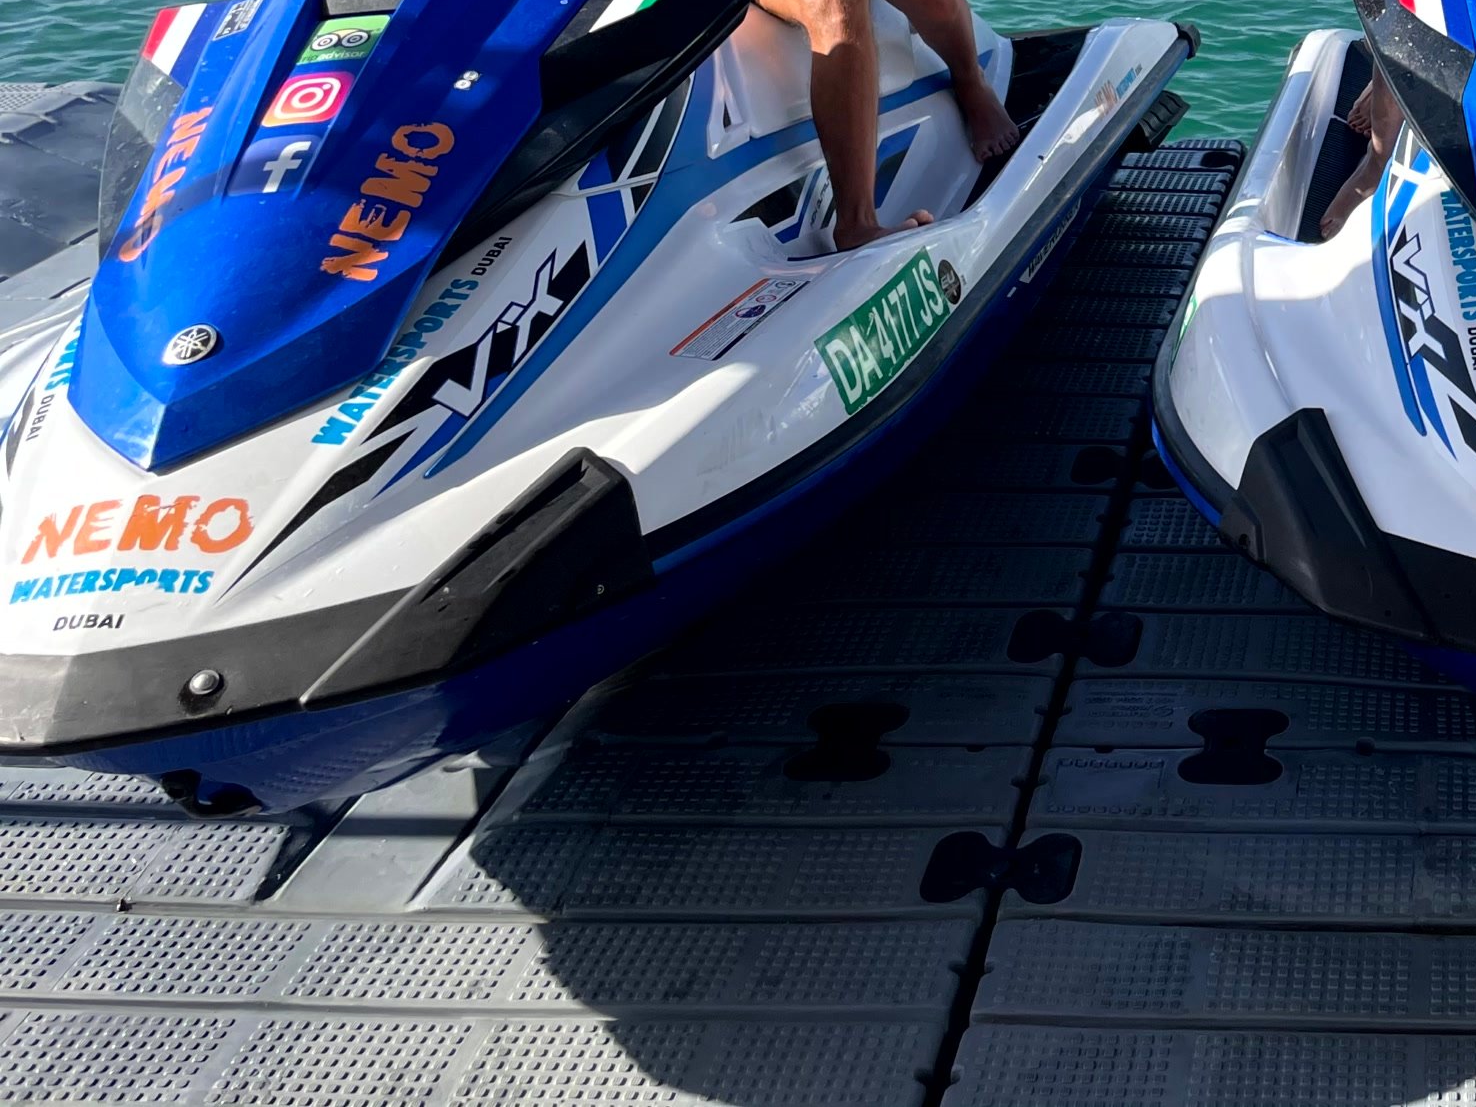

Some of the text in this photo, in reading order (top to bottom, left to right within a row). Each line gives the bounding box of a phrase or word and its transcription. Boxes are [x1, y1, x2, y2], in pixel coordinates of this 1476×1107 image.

[320, 122, 456, 282] NEMO
[311, 236, 513, 445] WATERSPORTS DUBAI
[825, 325, 883, 405] DA
[868, 280, 920, 365] 4177
[913, 259, 944, 327] JS
[26, 394, 56, 442] DUBAI
[21, 494, 255, 564] NEMO
[9, 567, 215, 605] WATERSPORTS
[53, 613, 126, 631] DUBAI
